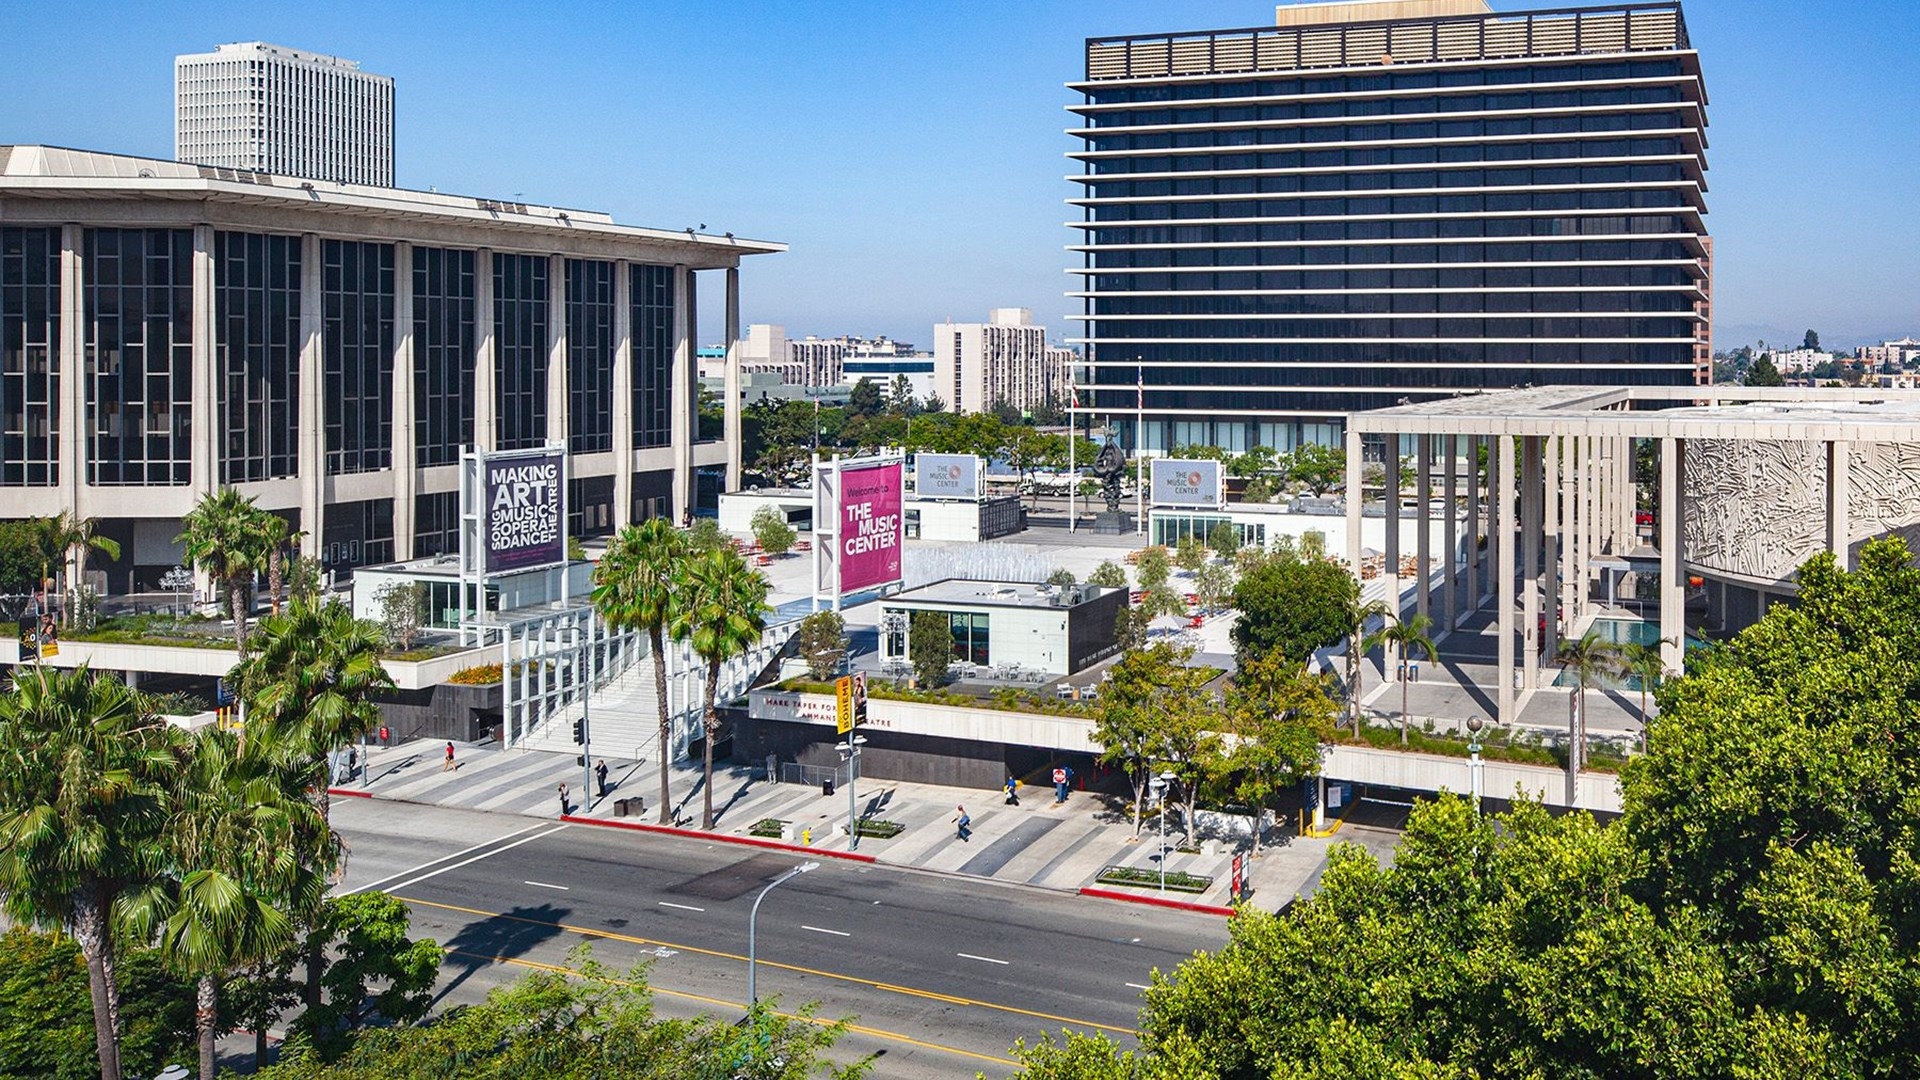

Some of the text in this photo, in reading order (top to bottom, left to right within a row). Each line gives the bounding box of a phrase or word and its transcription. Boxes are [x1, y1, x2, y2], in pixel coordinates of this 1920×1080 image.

[491, 464, 557, 485] MAKING
[929, 472, 948, 480] MUSIC
[1166, 479, 1187, 487] MUSIC
[846, 486, 889, 498] Welcome to
[936, 480, 959, 488] CENTER
[1174, 487, 1199, 495] CENTER
[492, 480, 548, 511] ART
[500, 505, 548, 523] MUSIC
[548, 479, 557, 541] THEATRE
[846, 502, 872, 522] THE
[491, 510, 501, 551] SONG
[500, 518, 549, 536] OPERA
[858, 514, 898, 537] MUSIC
[500, 532, 549, 550] DANCE
[845, 533, 896, 556] CENTER
[792, 701, 818, 710] TAPER
